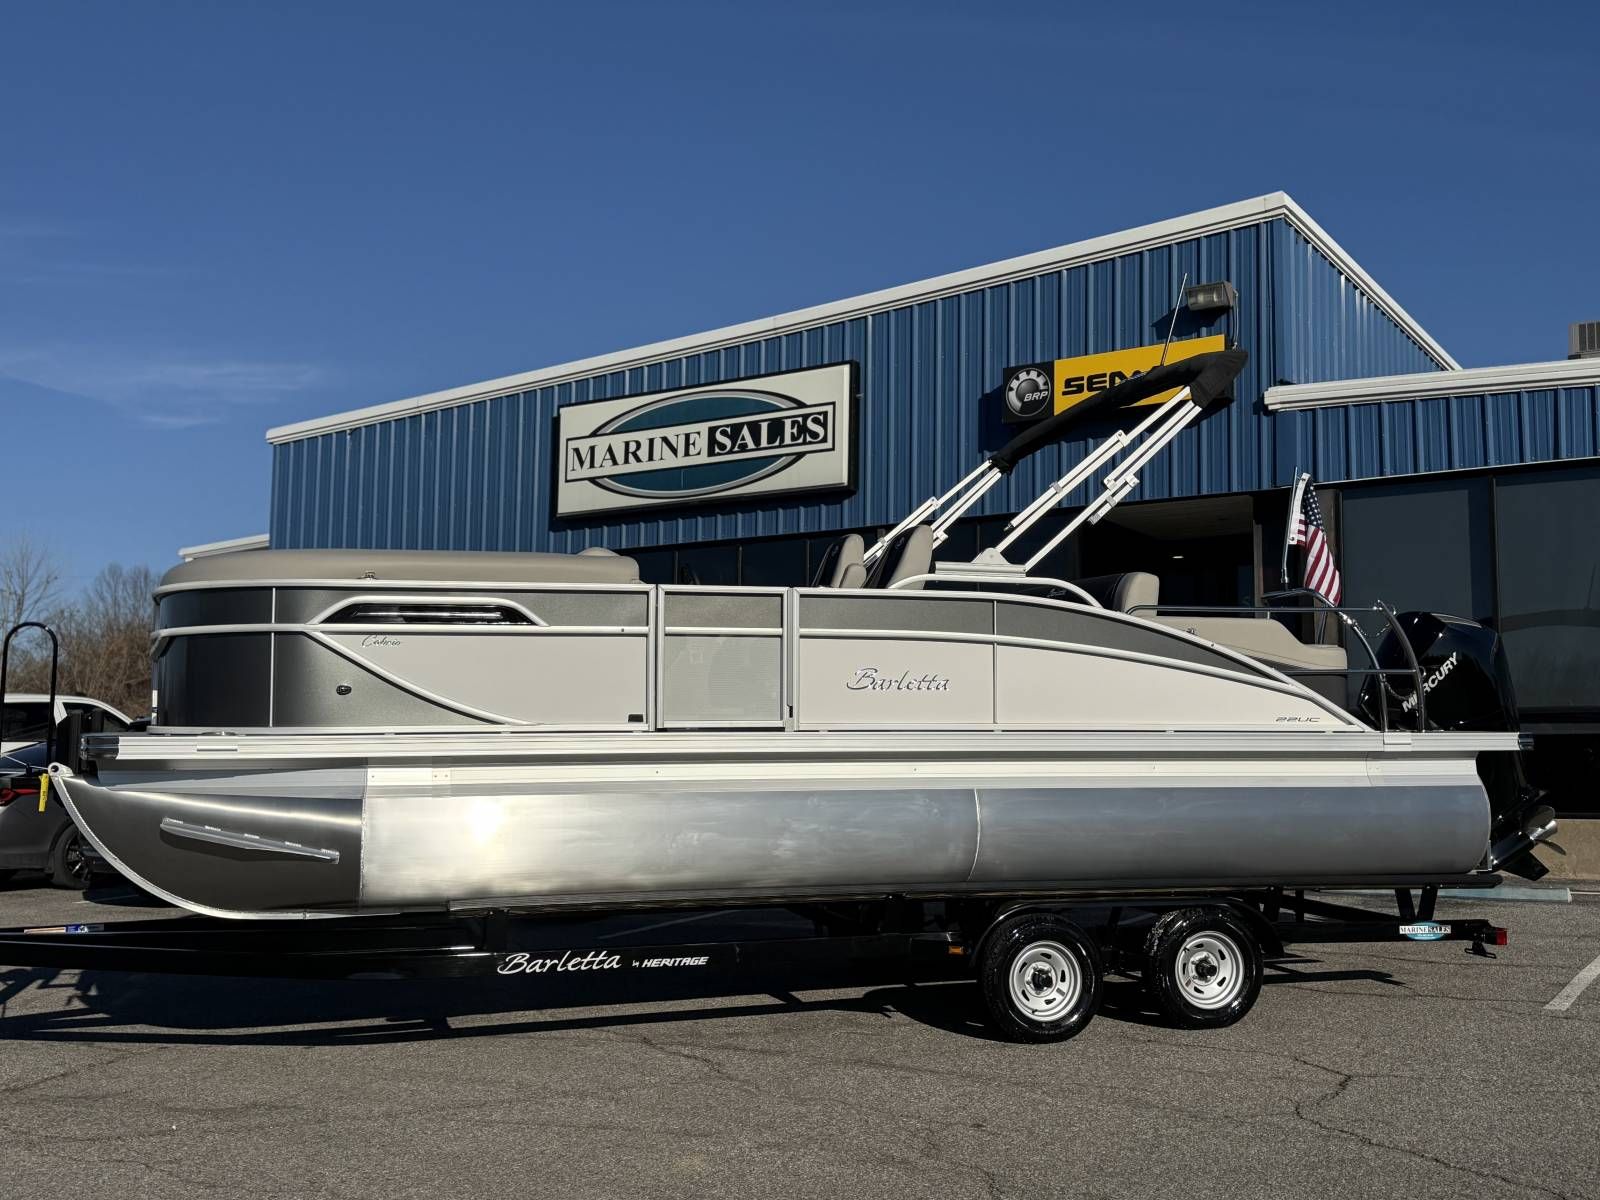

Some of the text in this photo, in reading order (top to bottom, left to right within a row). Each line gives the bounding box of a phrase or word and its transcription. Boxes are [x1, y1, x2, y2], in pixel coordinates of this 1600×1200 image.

[1023, 391, 1049, 402] BRP
[569, 413, 827, 472] MARINE SALES
[846, 667, 950, 692] Barletta
[1400, 925, 1451, 934] MARINE SALES
[496, 950, 622, 975] Barletta
[641, 956, 710, 968] HERITAGE
